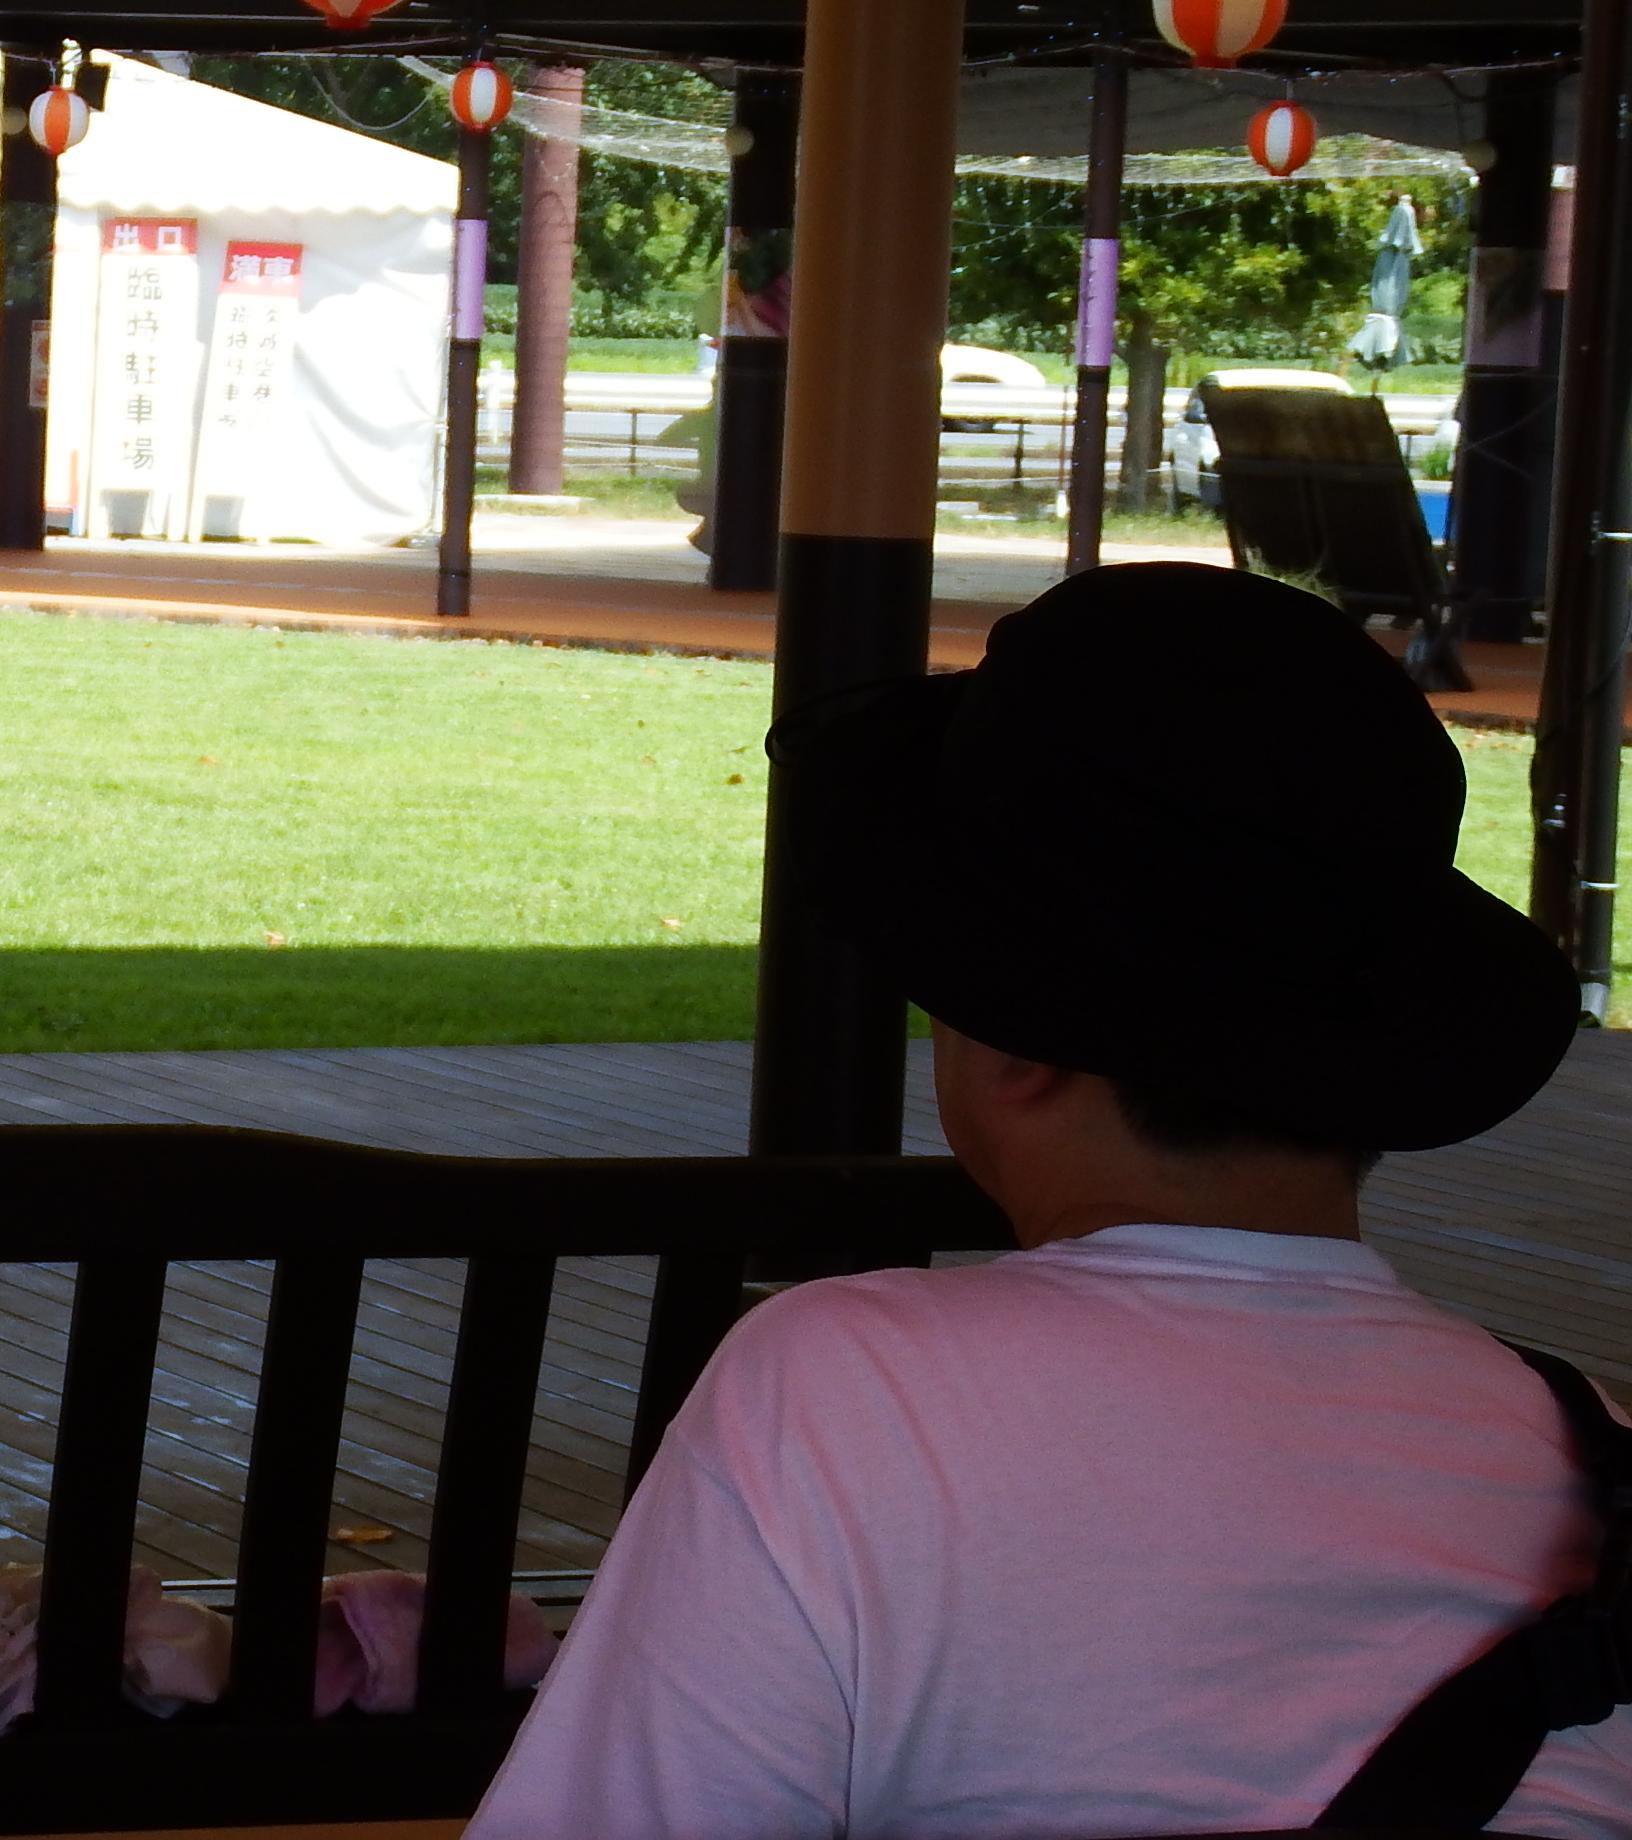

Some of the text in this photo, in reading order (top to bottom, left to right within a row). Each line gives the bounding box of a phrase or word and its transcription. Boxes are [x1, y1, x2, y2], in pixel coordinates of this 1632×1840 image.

[112, 223, 183, 253] 出口
[124, 267, 162, 470] 臨時駐車場
